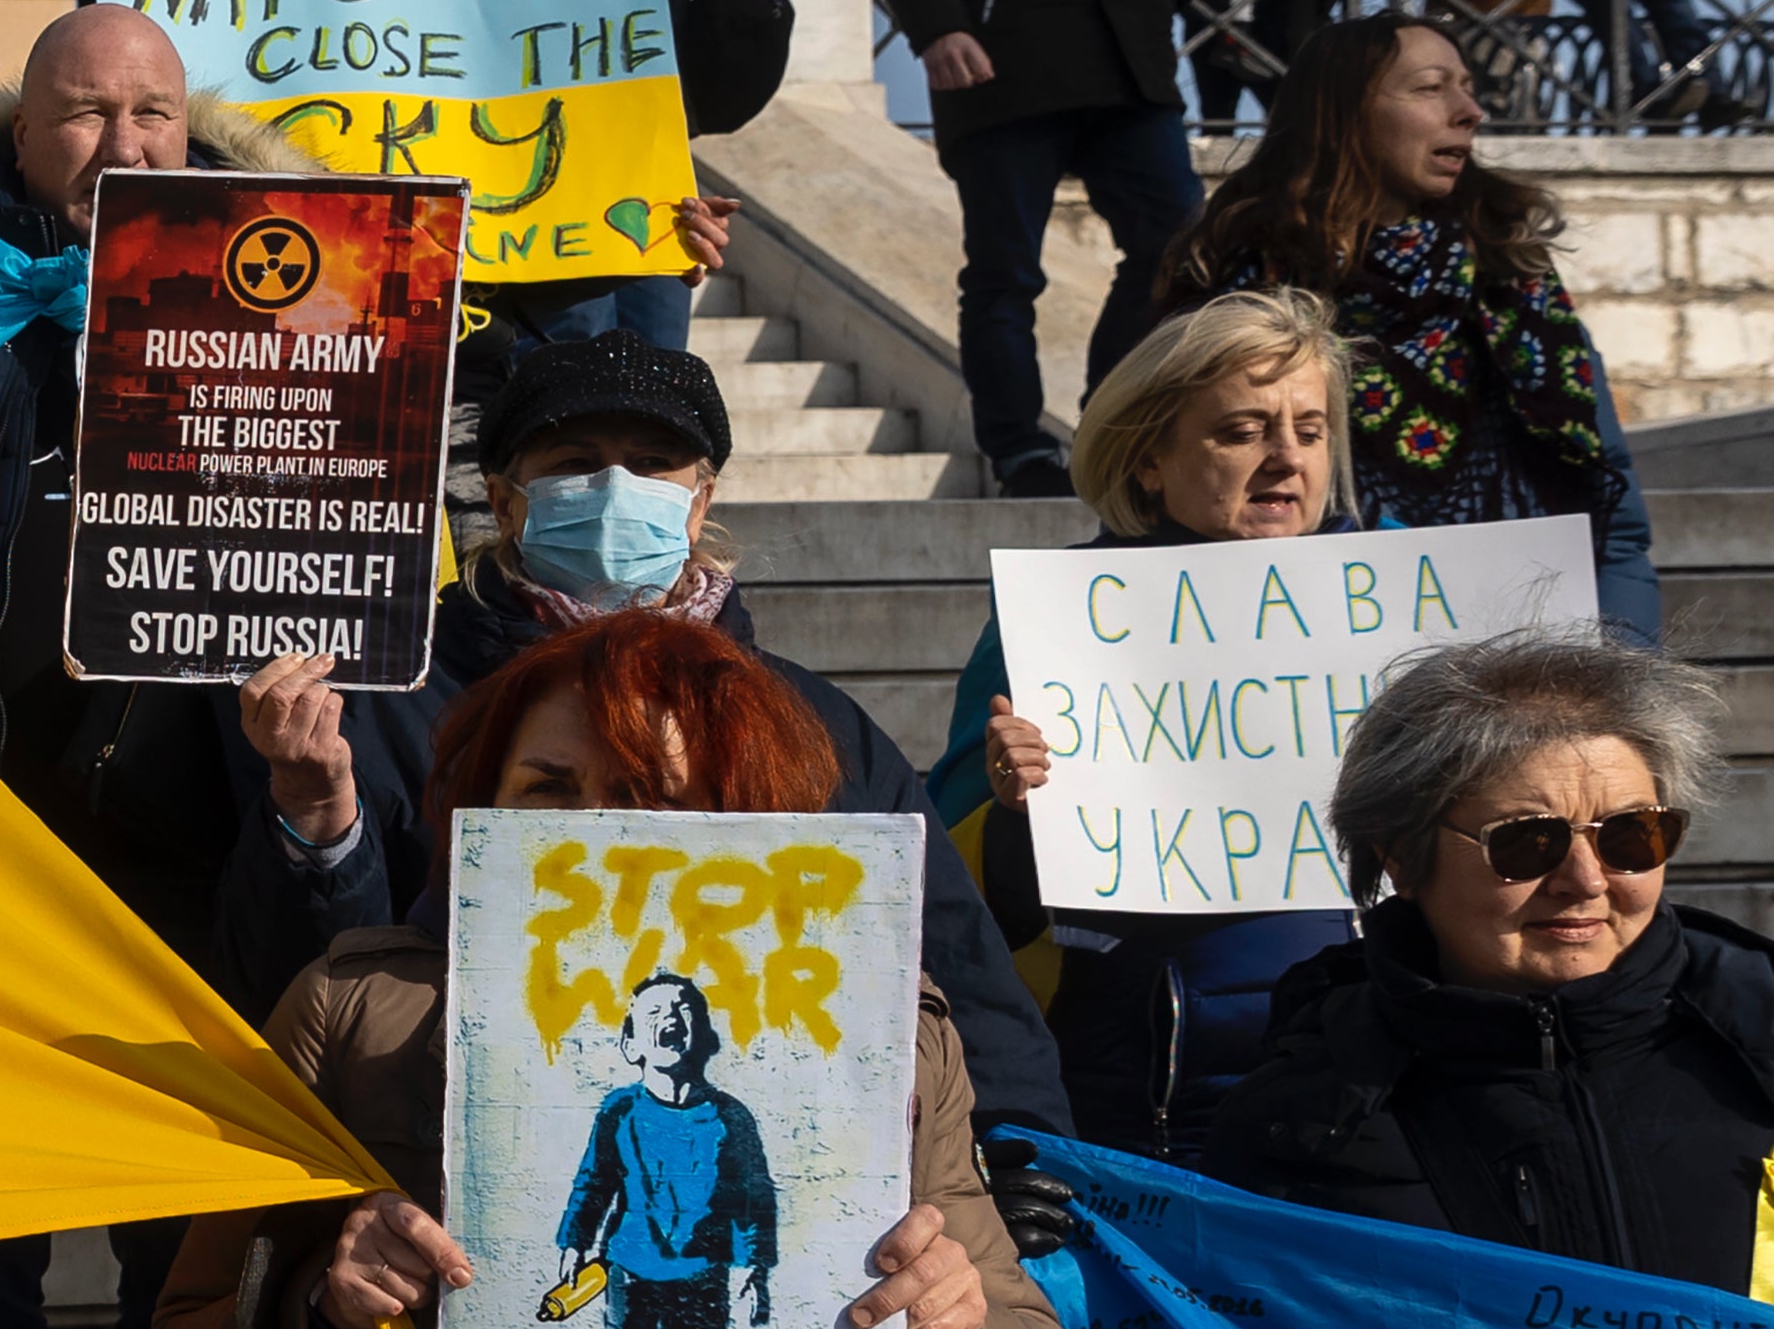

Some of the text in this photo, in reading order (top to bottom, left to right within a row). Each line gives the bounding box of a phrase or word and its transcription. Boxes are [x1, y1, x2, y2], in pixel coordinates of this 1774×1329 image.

[245, 8, 666, 89] CLOSE THE
[144, 329, 385, 374] RUSSIAN ARMY
[189, 384, 333, 413] IS FIRING UPON
[178, 415, 341, 451] THE BIGGEST
[127, 451, 388, 479] NUCLEAR POWER PLANT IN EUROPE
[81, 492, 425, 535] GLOBAL DISASTER IS REAL!
[105, 545, 394, 598] SAVE YOURSELF!
[1087, 553, 1460, 646] СЛАВА
[128, 611, 364, 661] STOP RUSSIA!
[526, 840, 863, 946] STOP
[526, 928, 843, 1058] WAR
